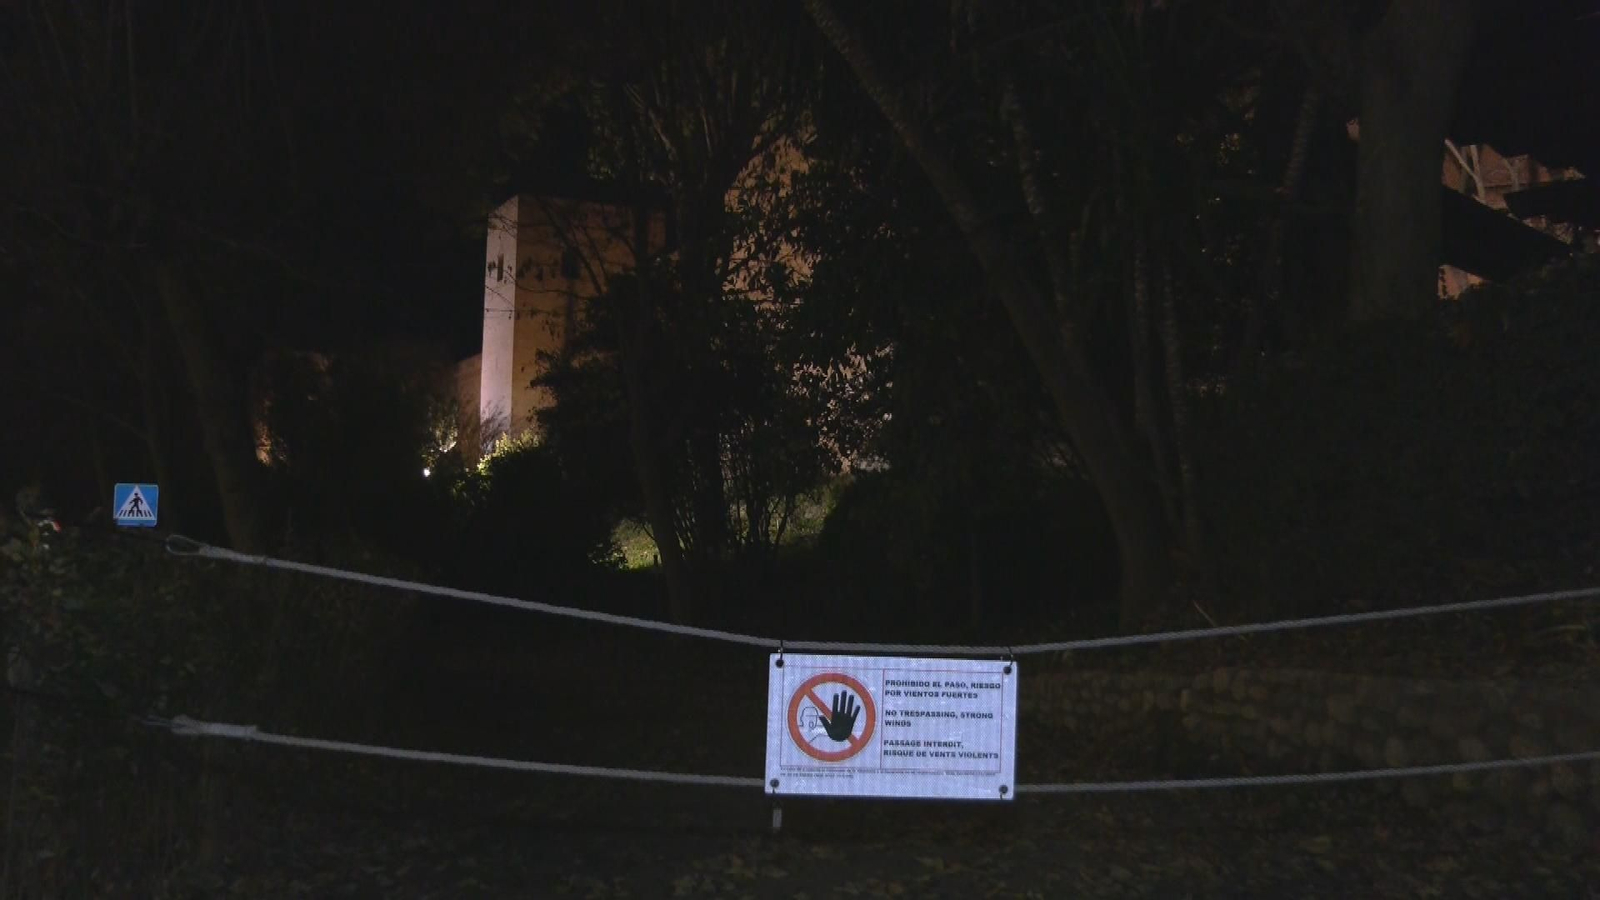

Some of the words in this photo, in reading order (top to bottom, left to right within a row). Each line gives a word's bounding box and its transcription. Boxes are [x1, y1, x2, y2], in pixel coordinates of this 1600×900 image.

[885, 679, 930, 688] PROHIBIDO
[944, 681, 969, 689] PASO,
[900, 710, 958, 719] TRESPASSING,
[960, 711, 993, 719] STRONG
[883, 739, 921, 747] PASSAGE
[923, 740, 964, 749] INTERDIT,
[883, 749, 914, 757] RISQUE
